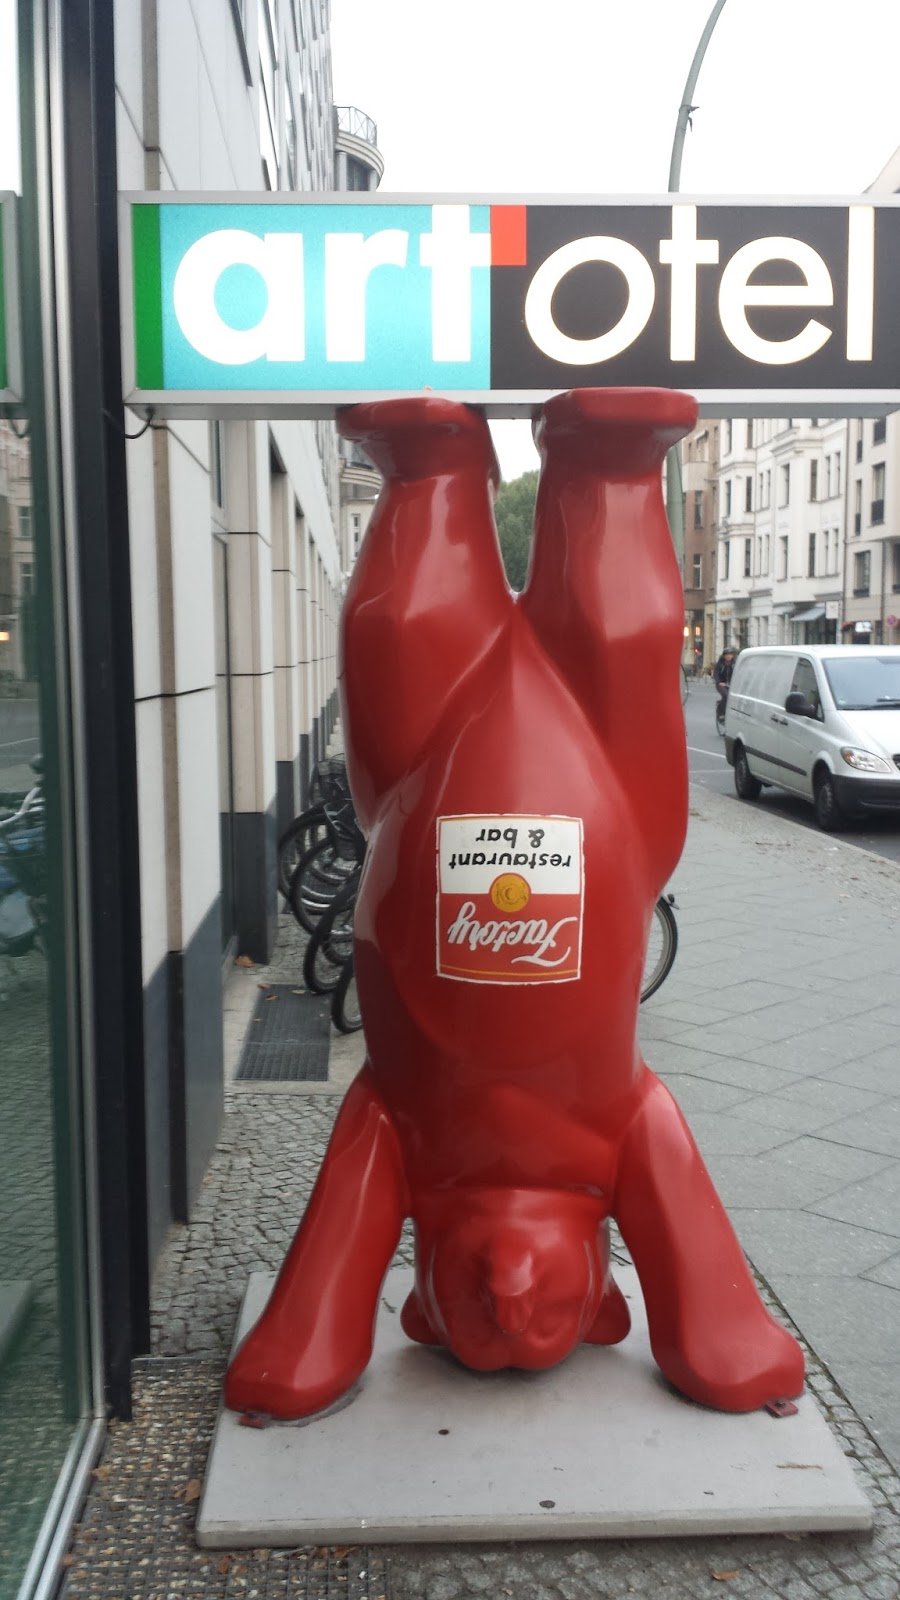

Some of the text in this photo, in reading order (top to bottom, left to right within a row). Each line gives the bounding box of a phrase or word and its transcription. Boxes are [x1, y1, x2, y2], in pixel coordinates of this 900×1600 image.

[475, 828, 545, 849] & bar
[448, 853, 571, 869] restaurant
[447, 901, 578, 967] Factory
